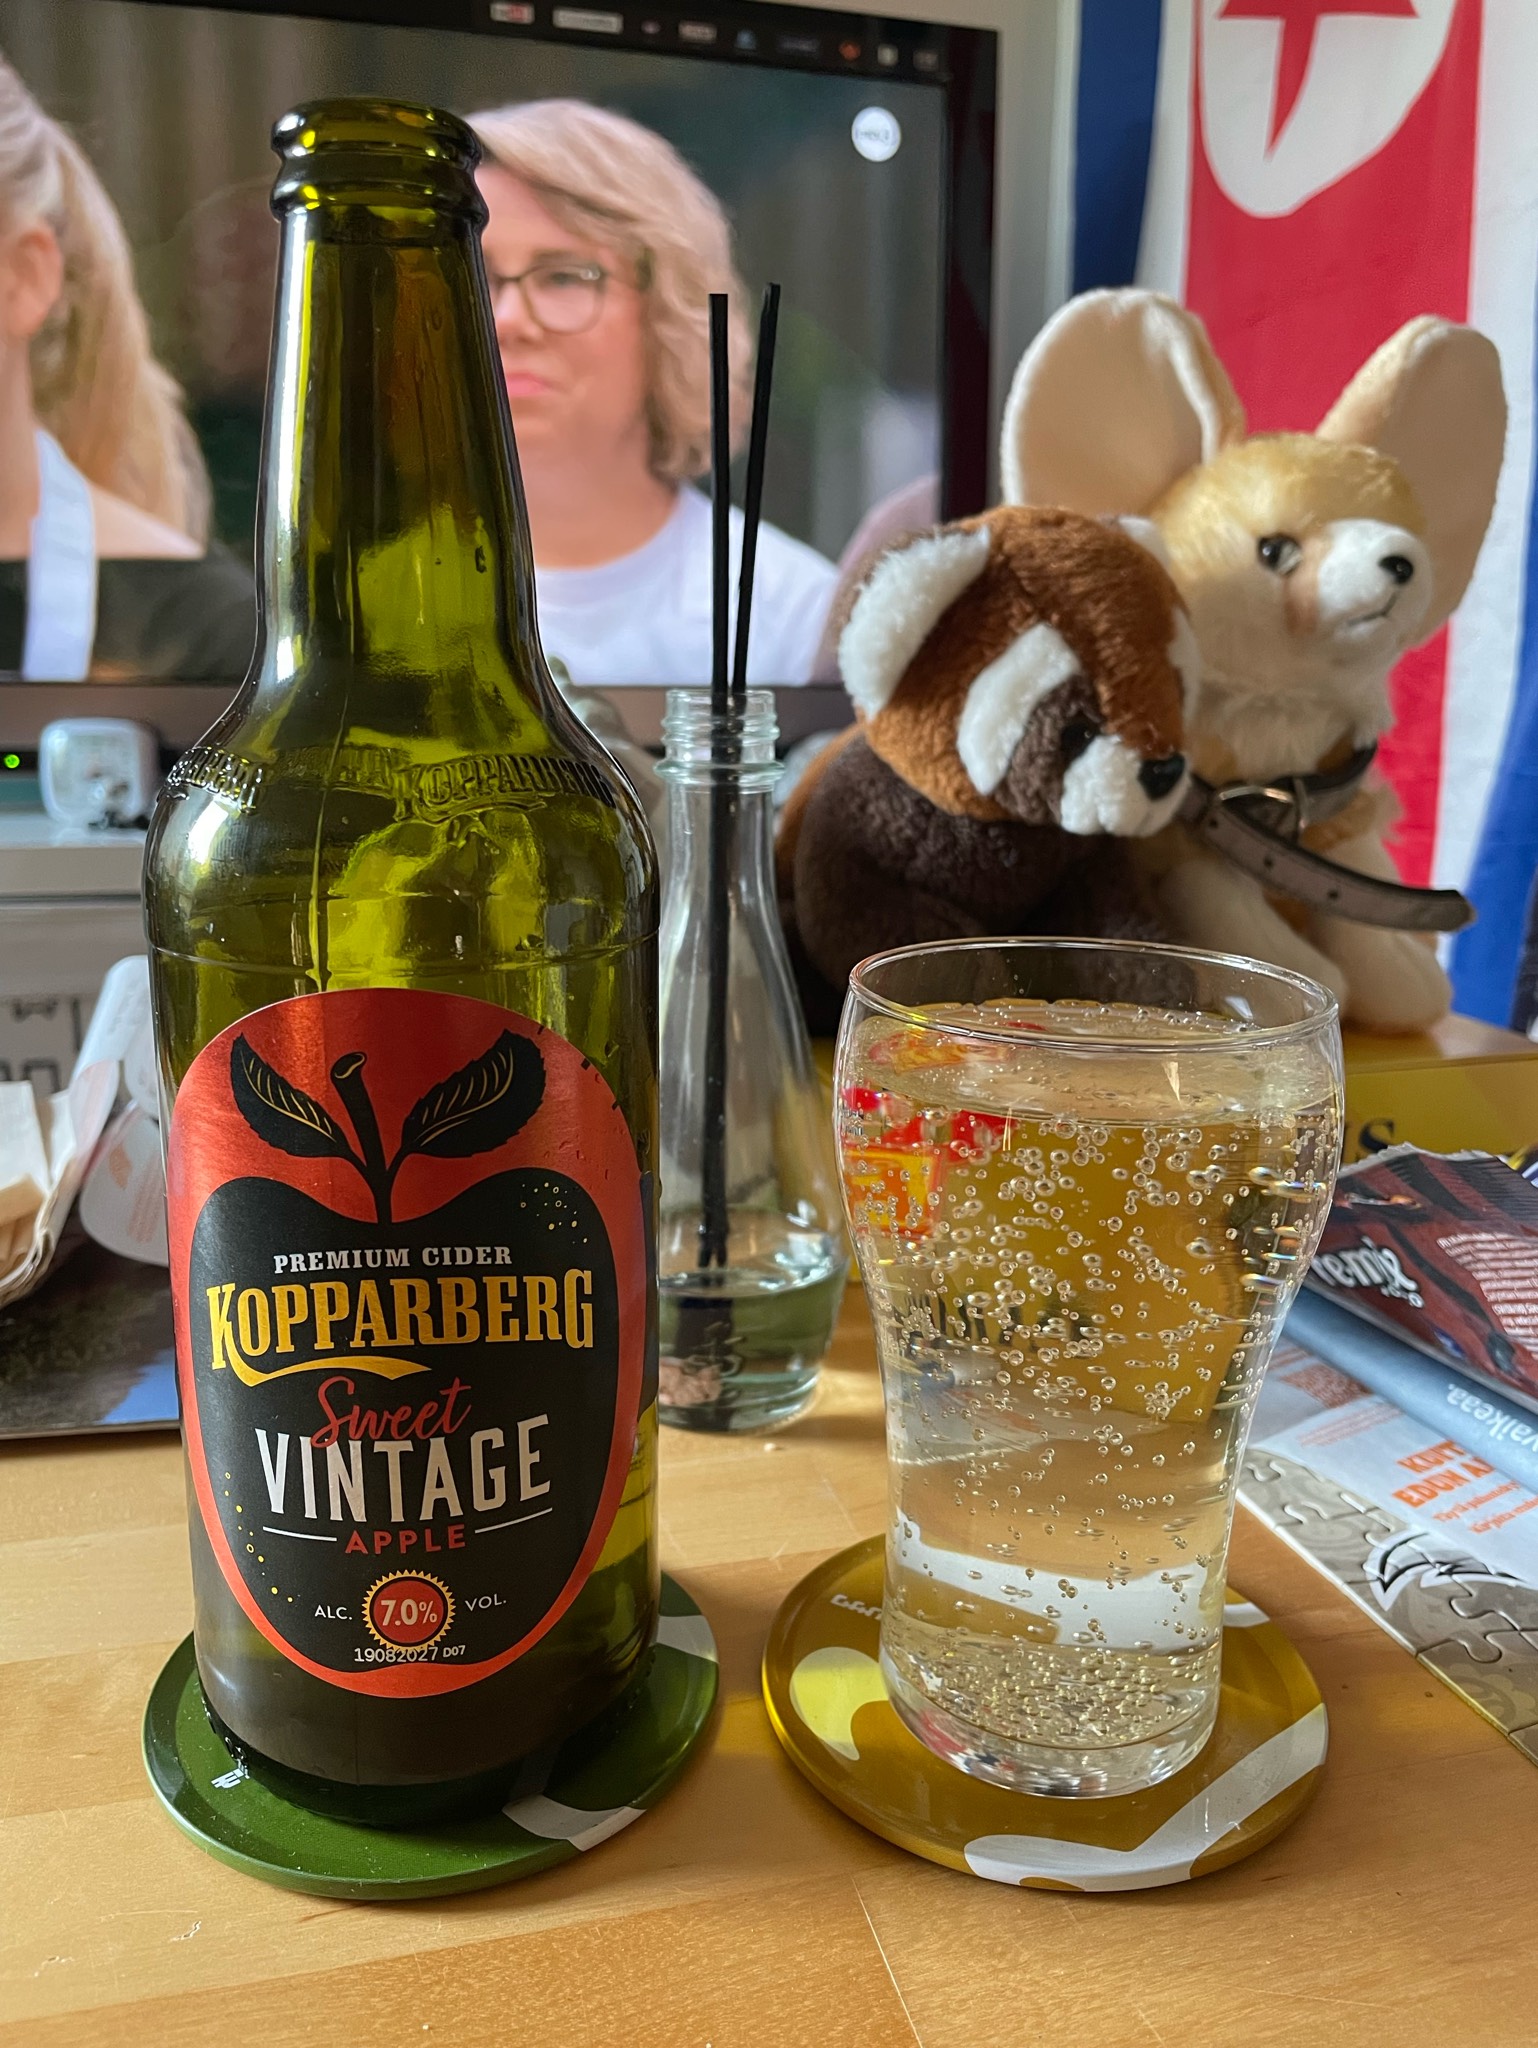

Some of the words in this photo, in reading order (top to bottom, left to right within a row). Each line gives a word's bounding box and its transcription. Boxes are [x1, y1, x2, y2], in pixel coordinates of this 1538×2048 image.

[273, 1248, 410, 1274] PREMIUM
[421, 1246, 512, 1268] CIDER
[206, 1268, 594, 1386] KOPPARBERG
[310, 1375, 472, 1449] Sweet
[255, 1414, 551, 1522] VINTAGE
[344, 1524, 466, 1554] APPLE
[314, 1604, 353, 1620] ALC.
[380, 1598, 438, 1627] 7.0%
[464, 1593, 507, 1612] VOL.
[354, 1646, 439, 1663] 19082027
